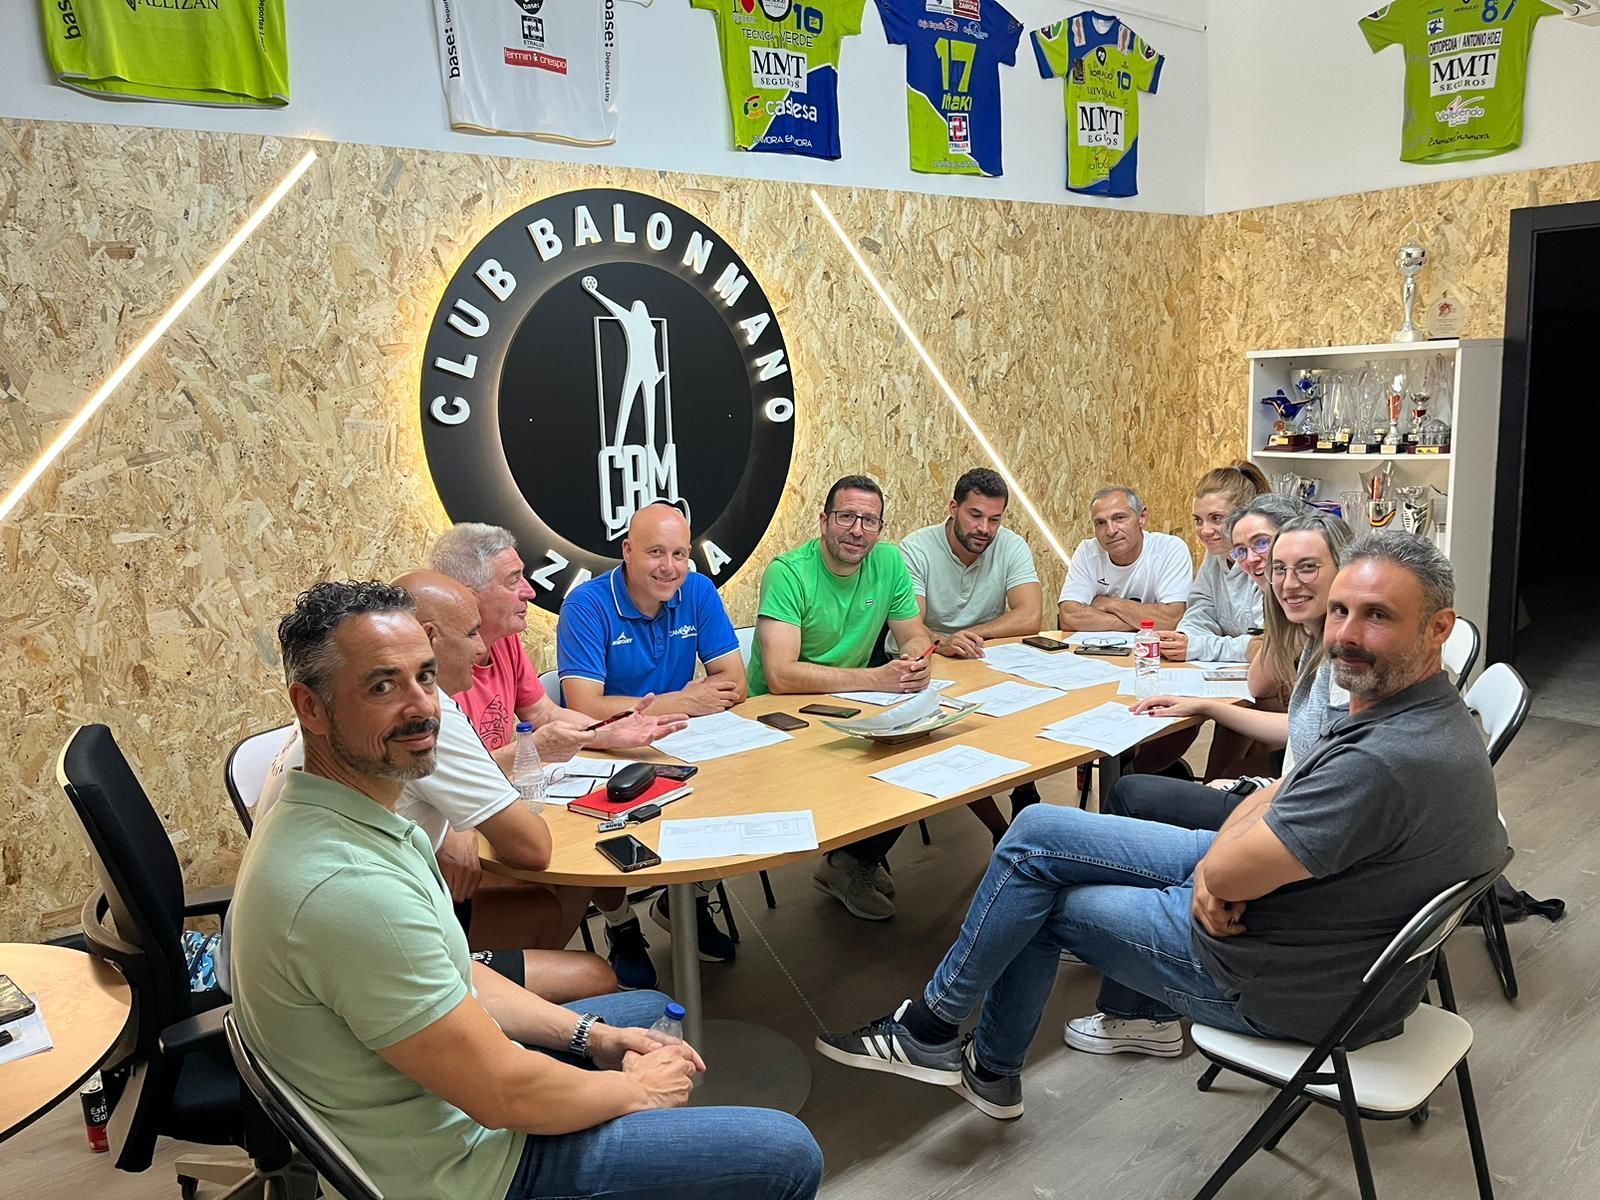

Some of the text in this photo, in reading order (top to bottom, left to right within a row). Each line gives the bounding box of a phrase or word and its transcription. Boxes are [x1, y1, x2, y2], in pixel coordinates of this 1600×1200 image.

[64, 0, 82, 40] bas
[793, 3, 823, 34] 10
[445, 27, 460, 79] base:
[540, 56, 566, 69] crespo
[934, 37, 977, 93] 17
[1432, 53, 1496, 84] MMT
[1116, 70, 1132, 90] 10
[430, 203, 794, 425] CLUB BALONMANO
